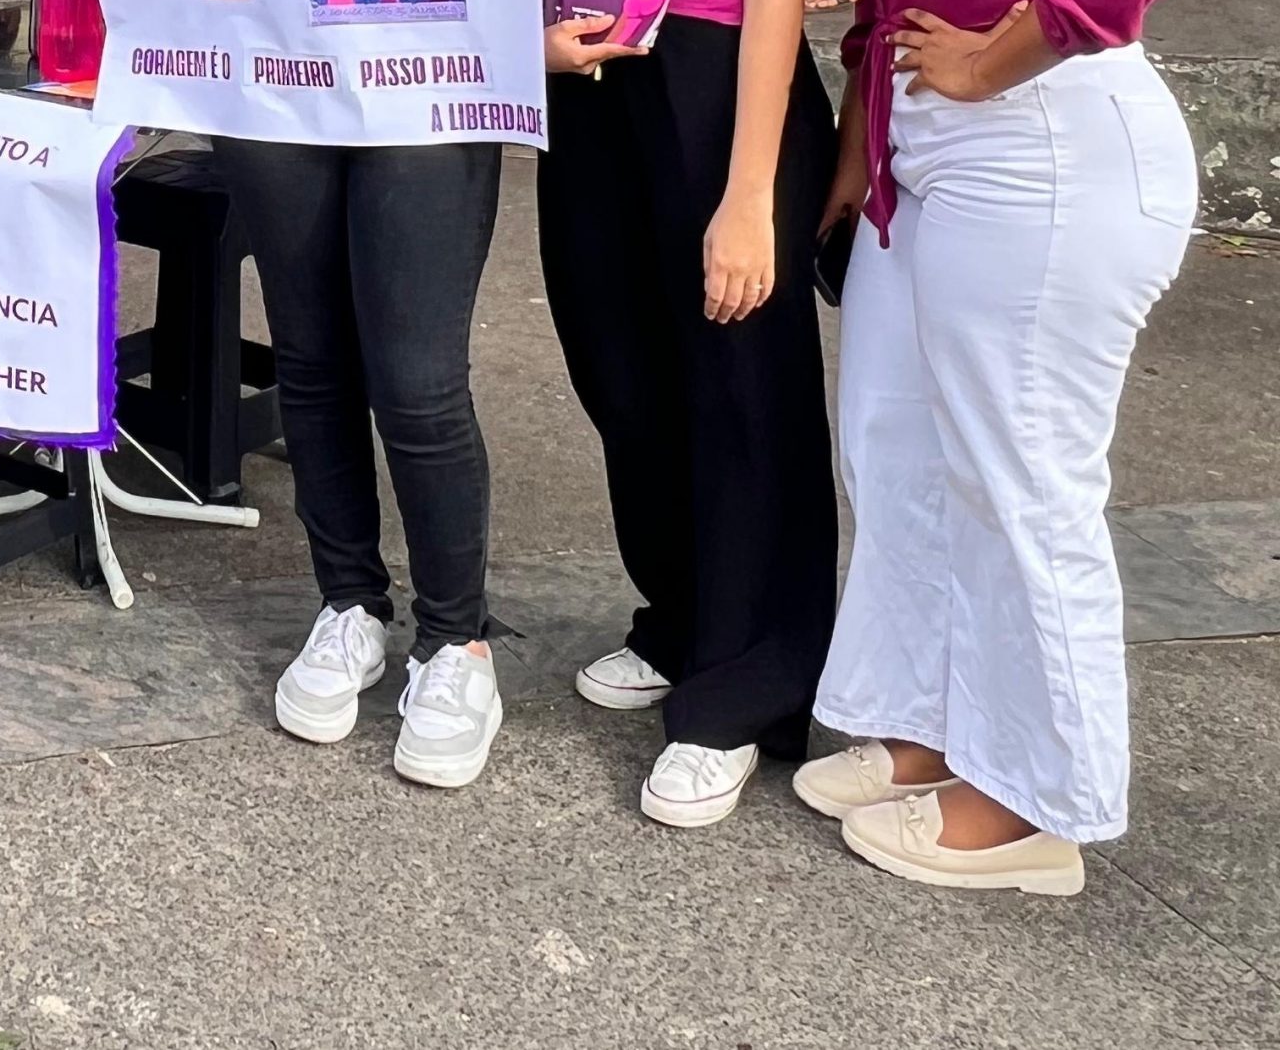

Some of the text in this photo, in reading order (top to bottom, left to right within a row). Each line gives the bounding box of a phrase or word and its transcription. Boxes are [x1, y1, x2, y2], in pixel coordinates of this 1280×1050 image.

[132, 45, 485, 88] CORAGEM É O PRIMEIRO PASSO PARA
[431, 103, 544, 137] A LIBERDADE
[29, 147, 50, 168] A
